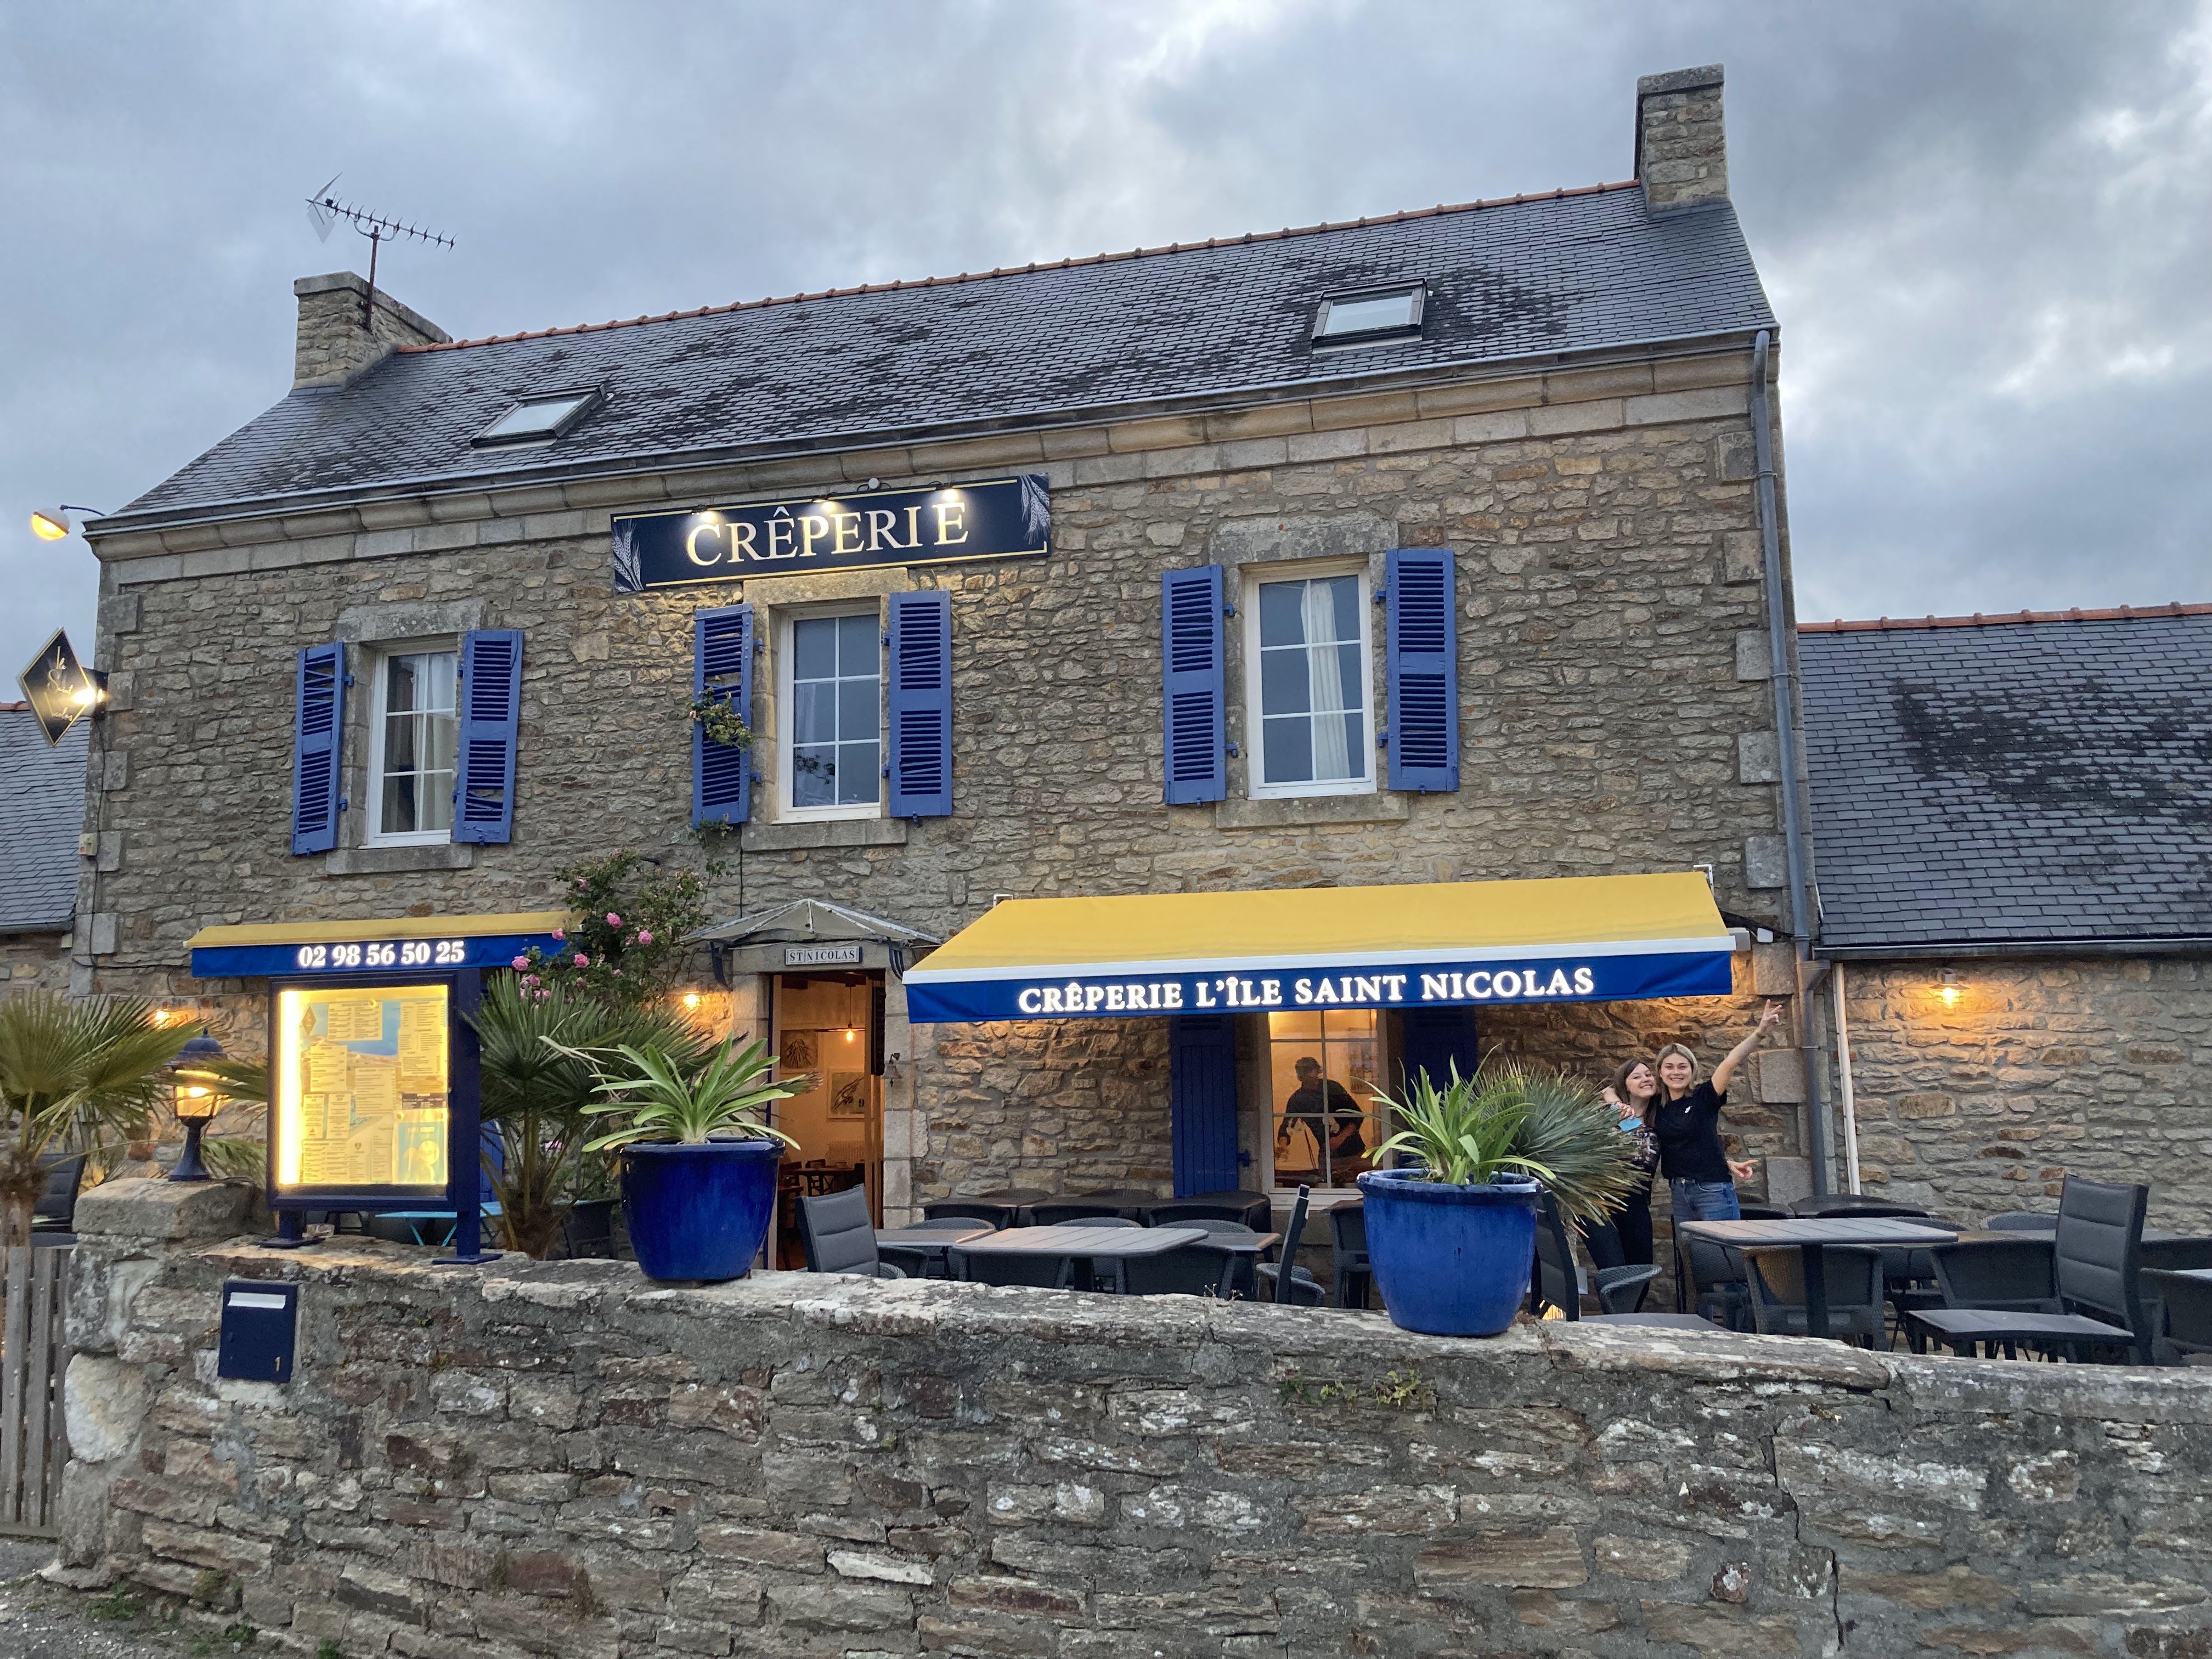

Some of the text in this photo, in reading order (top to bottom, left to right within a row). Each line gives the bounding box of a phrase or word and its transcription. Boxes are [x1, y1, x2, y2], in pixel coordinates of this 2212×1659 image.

[686, 502, 968, 566] CRÊPERIE
[299, 941, 465, 967] 02 98 56 50 25
[790, 950, 855, 961] ST NICOLAS
[1018, 968, 1594, 1013] CRÊPERIE L’ÎLE SAINT NICOLAS
[275, 1357, 280, 1372] 1
